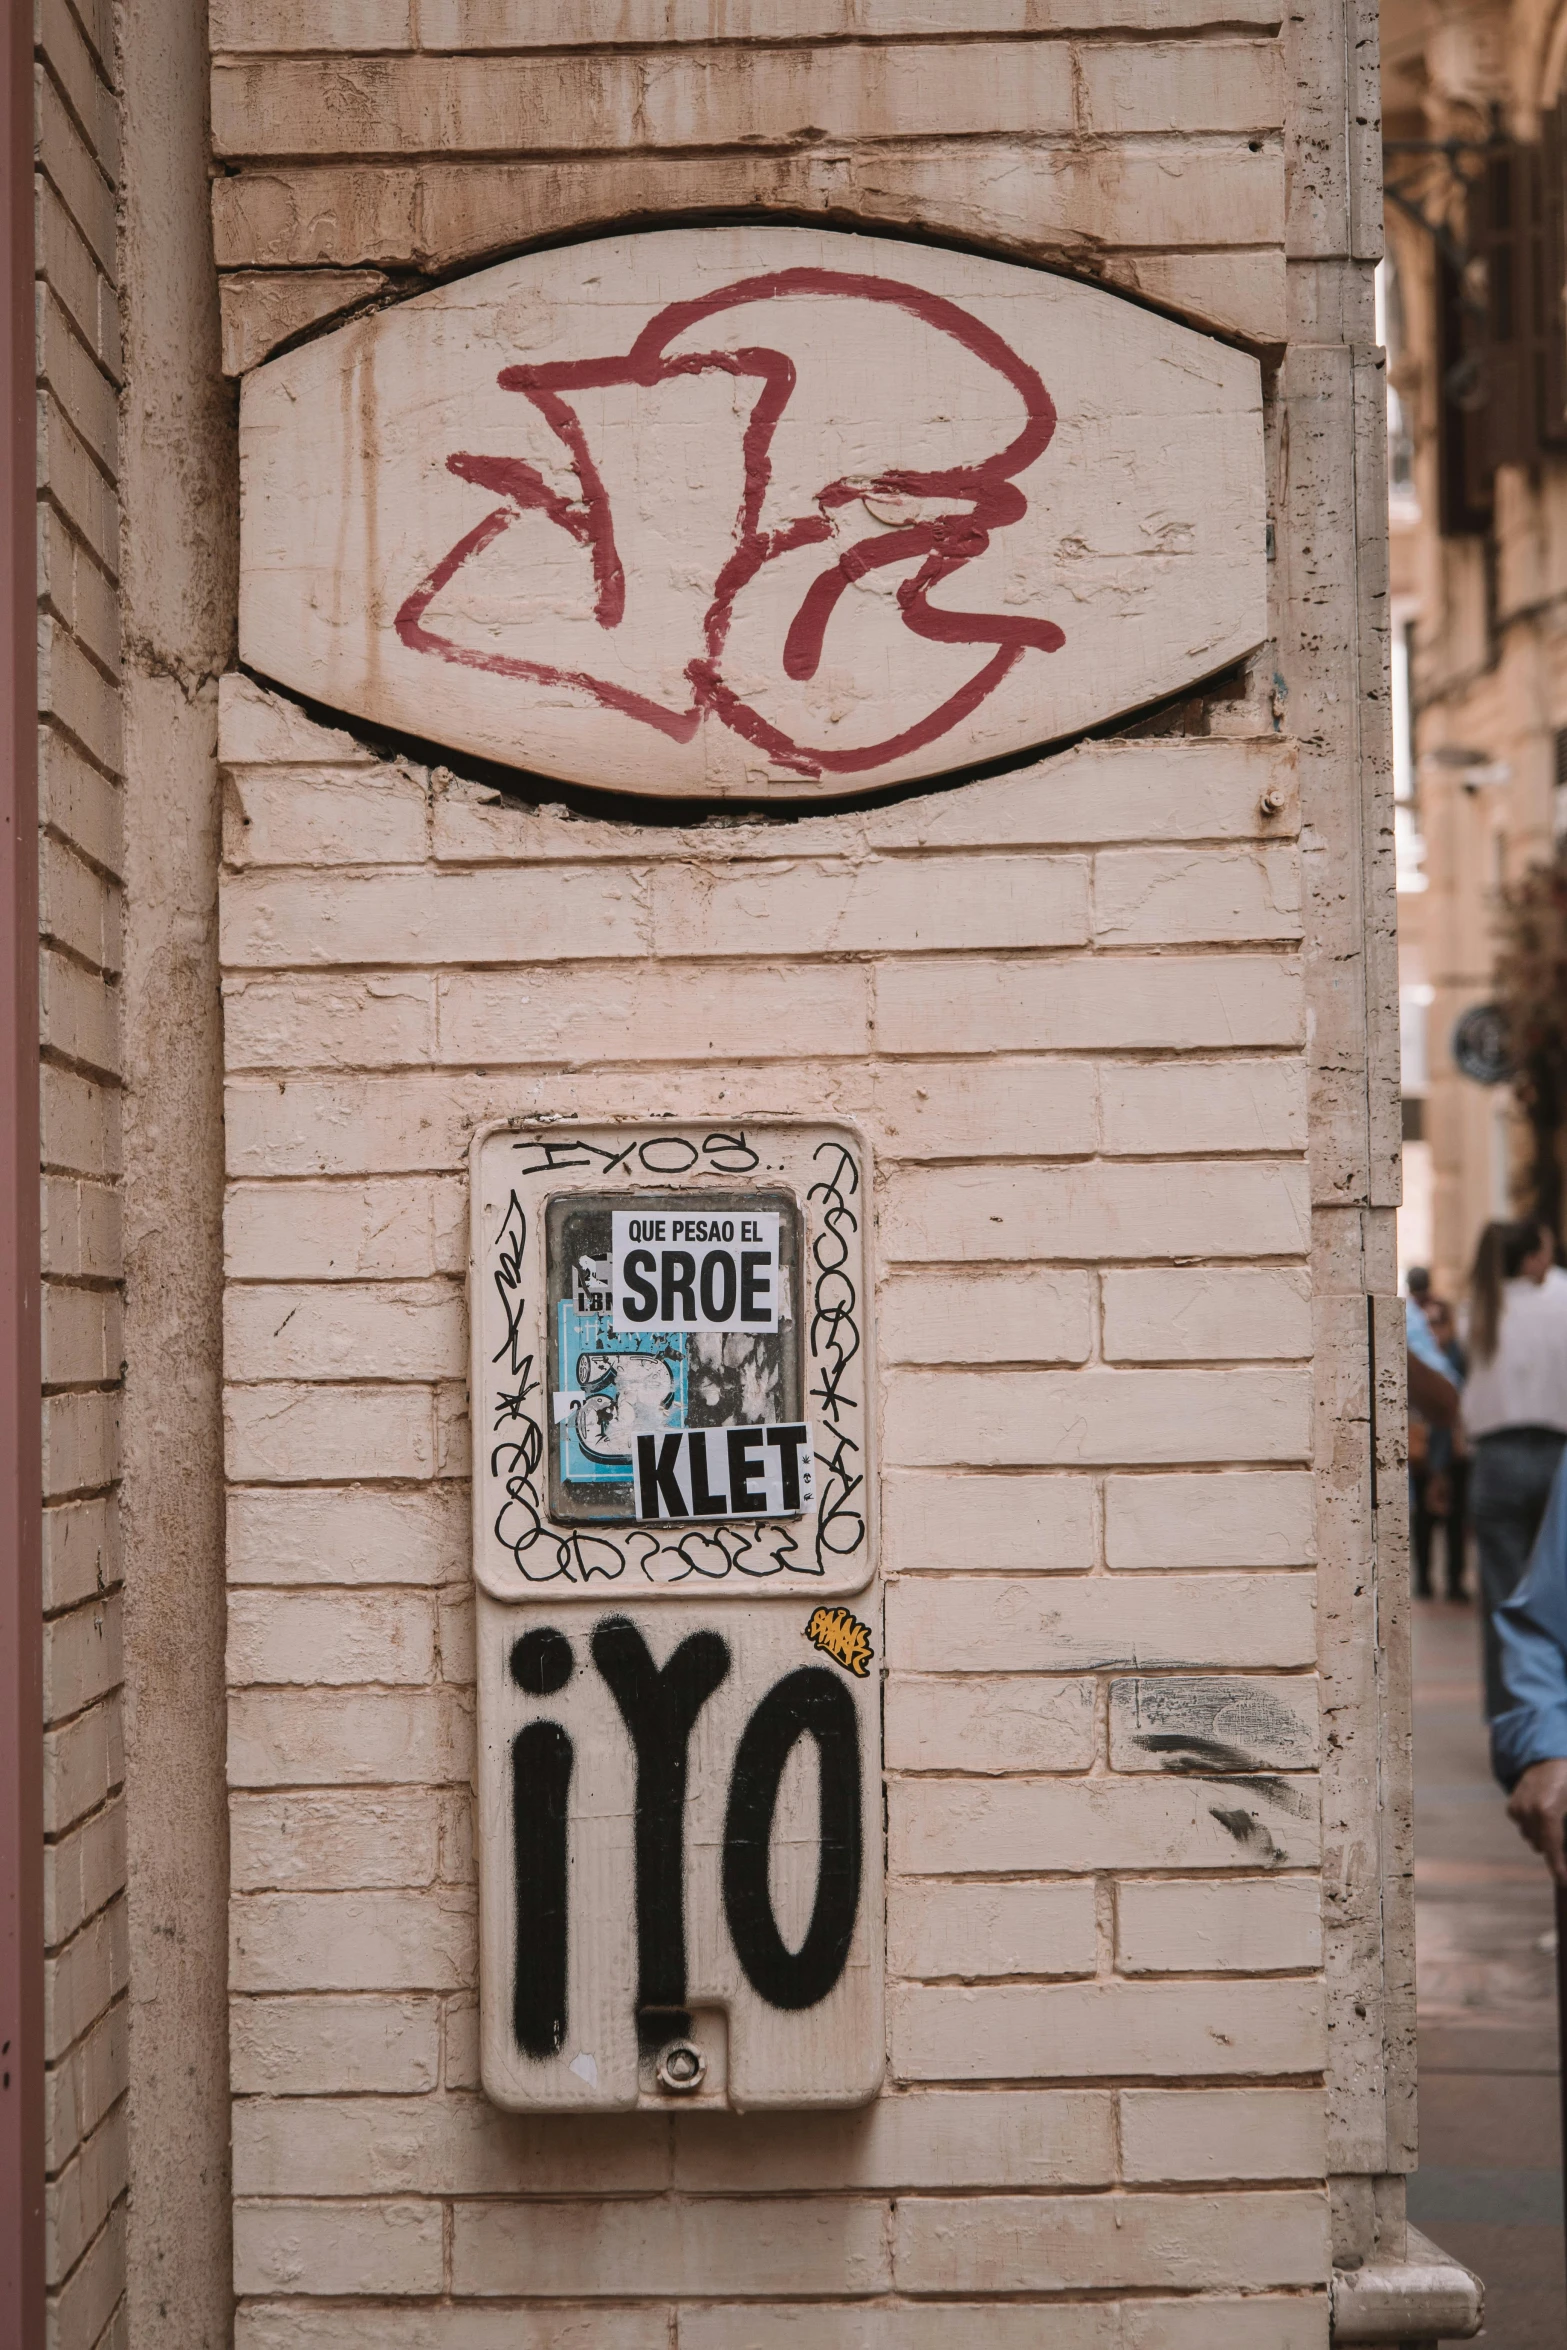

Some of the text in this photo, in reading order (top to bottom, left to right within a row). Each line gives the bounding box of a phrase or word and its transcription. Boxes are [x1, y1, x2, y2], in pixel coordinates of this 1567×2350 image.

[628, 1219, 763, 1244] QUE PESAO EL
[622, 1248, 772, 1323] SROE
[637, 1425, 807, 1519] KLET
